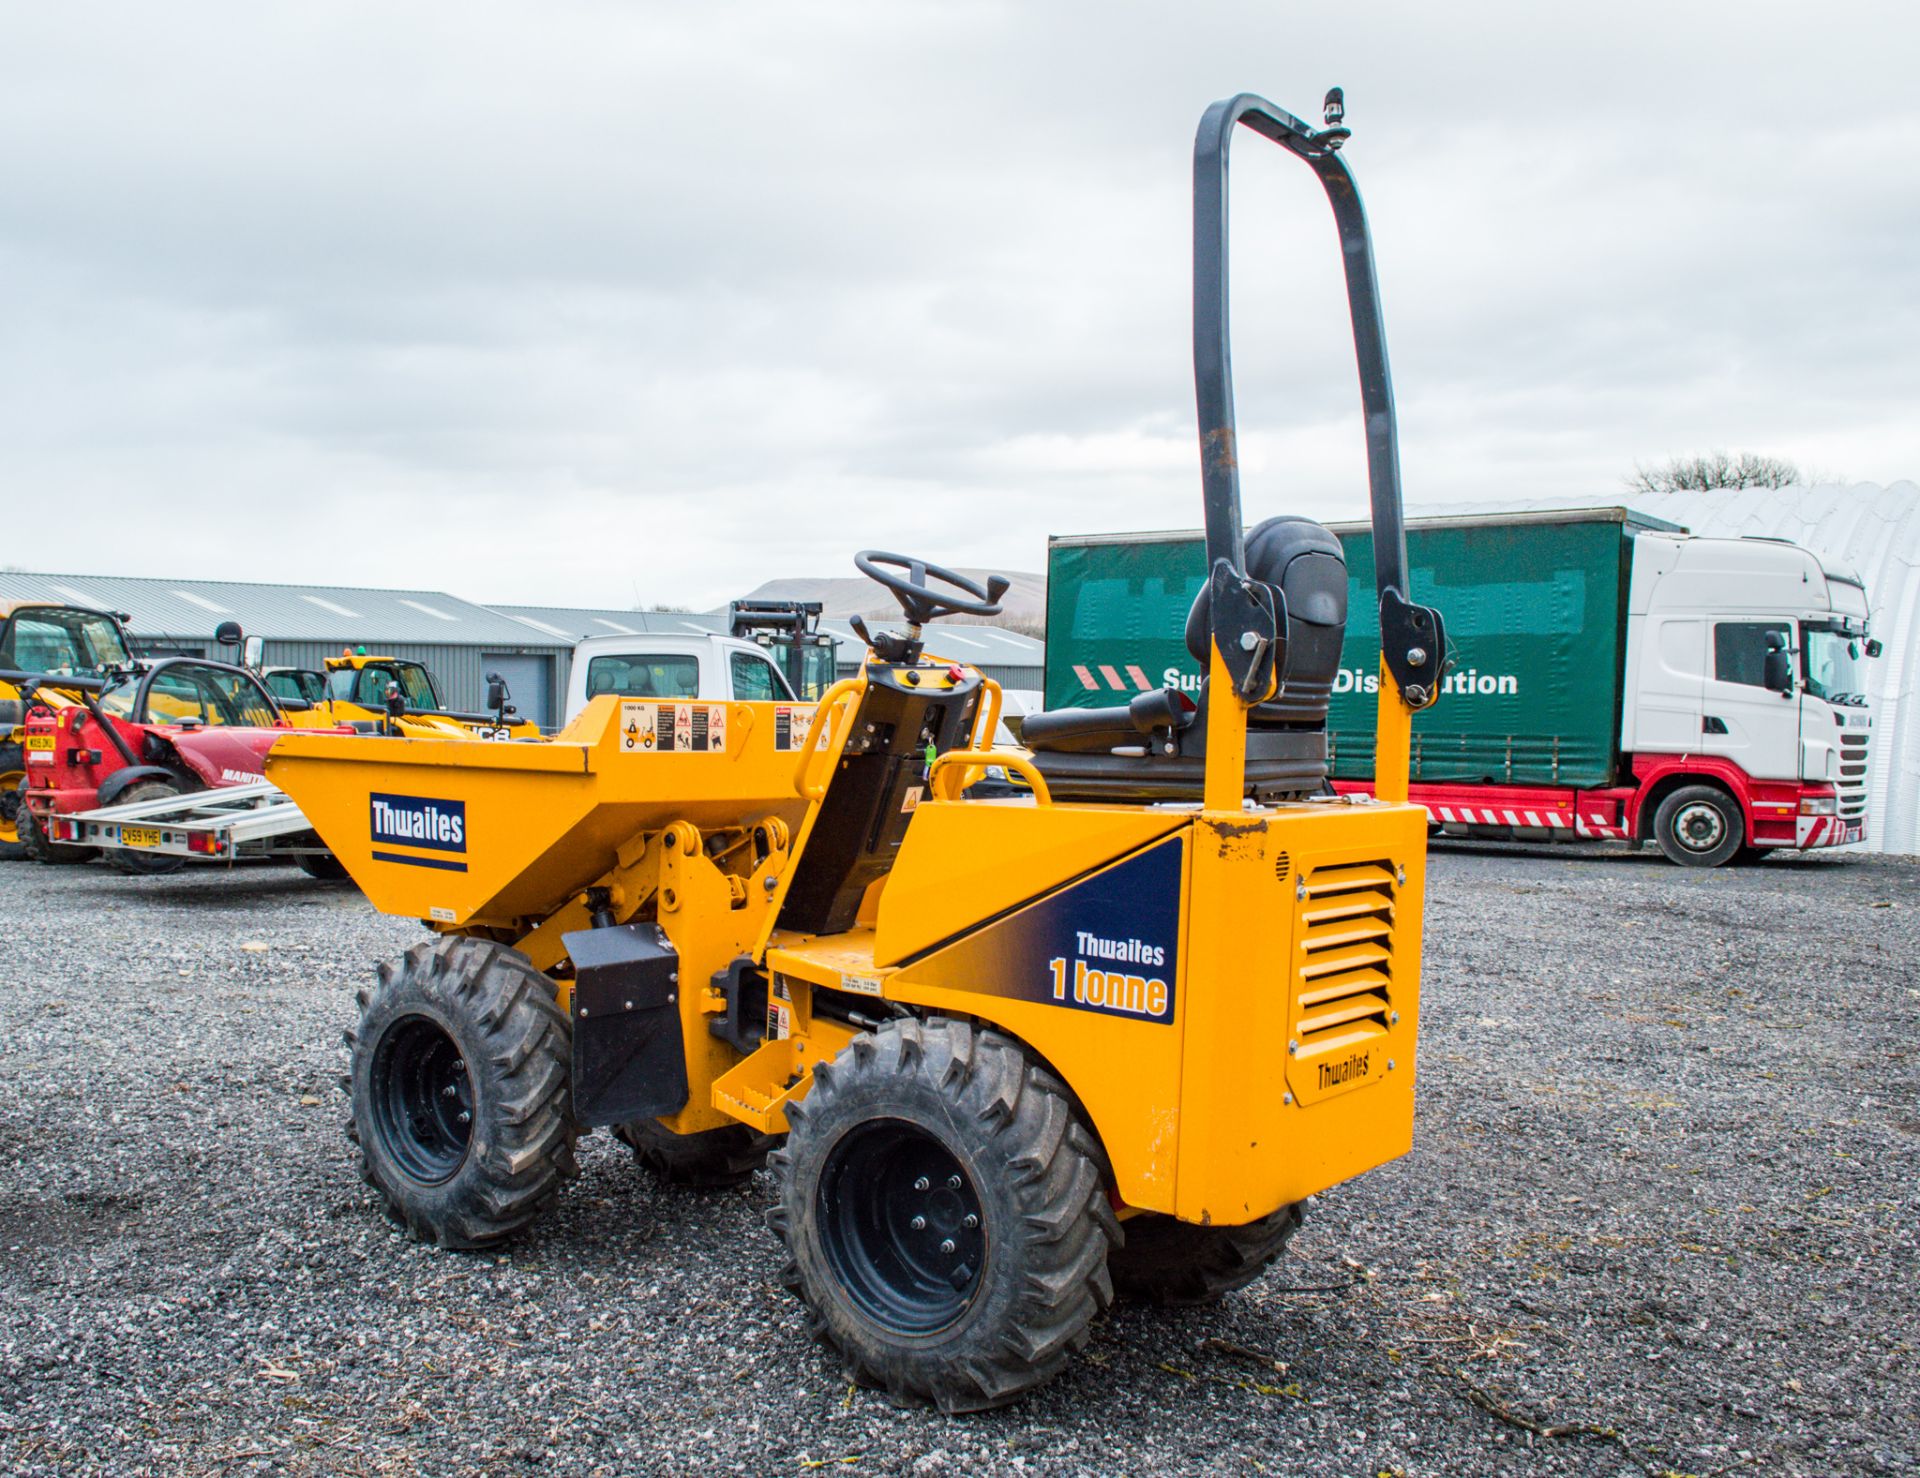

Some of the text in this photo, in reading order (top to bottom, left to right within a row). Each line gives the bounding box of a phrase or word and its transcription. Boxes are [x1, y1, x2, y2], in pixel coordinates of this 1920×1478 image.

[122, 828, 159, 844] CV59 YHE
[372, 800, 463, 844] Thwaites
[1076, 931, 1165, 966] Thwaites
[1050, 957, 1168, 1016] 1 tonne
[1318, 1053, 1369, 1090] Thwaites
